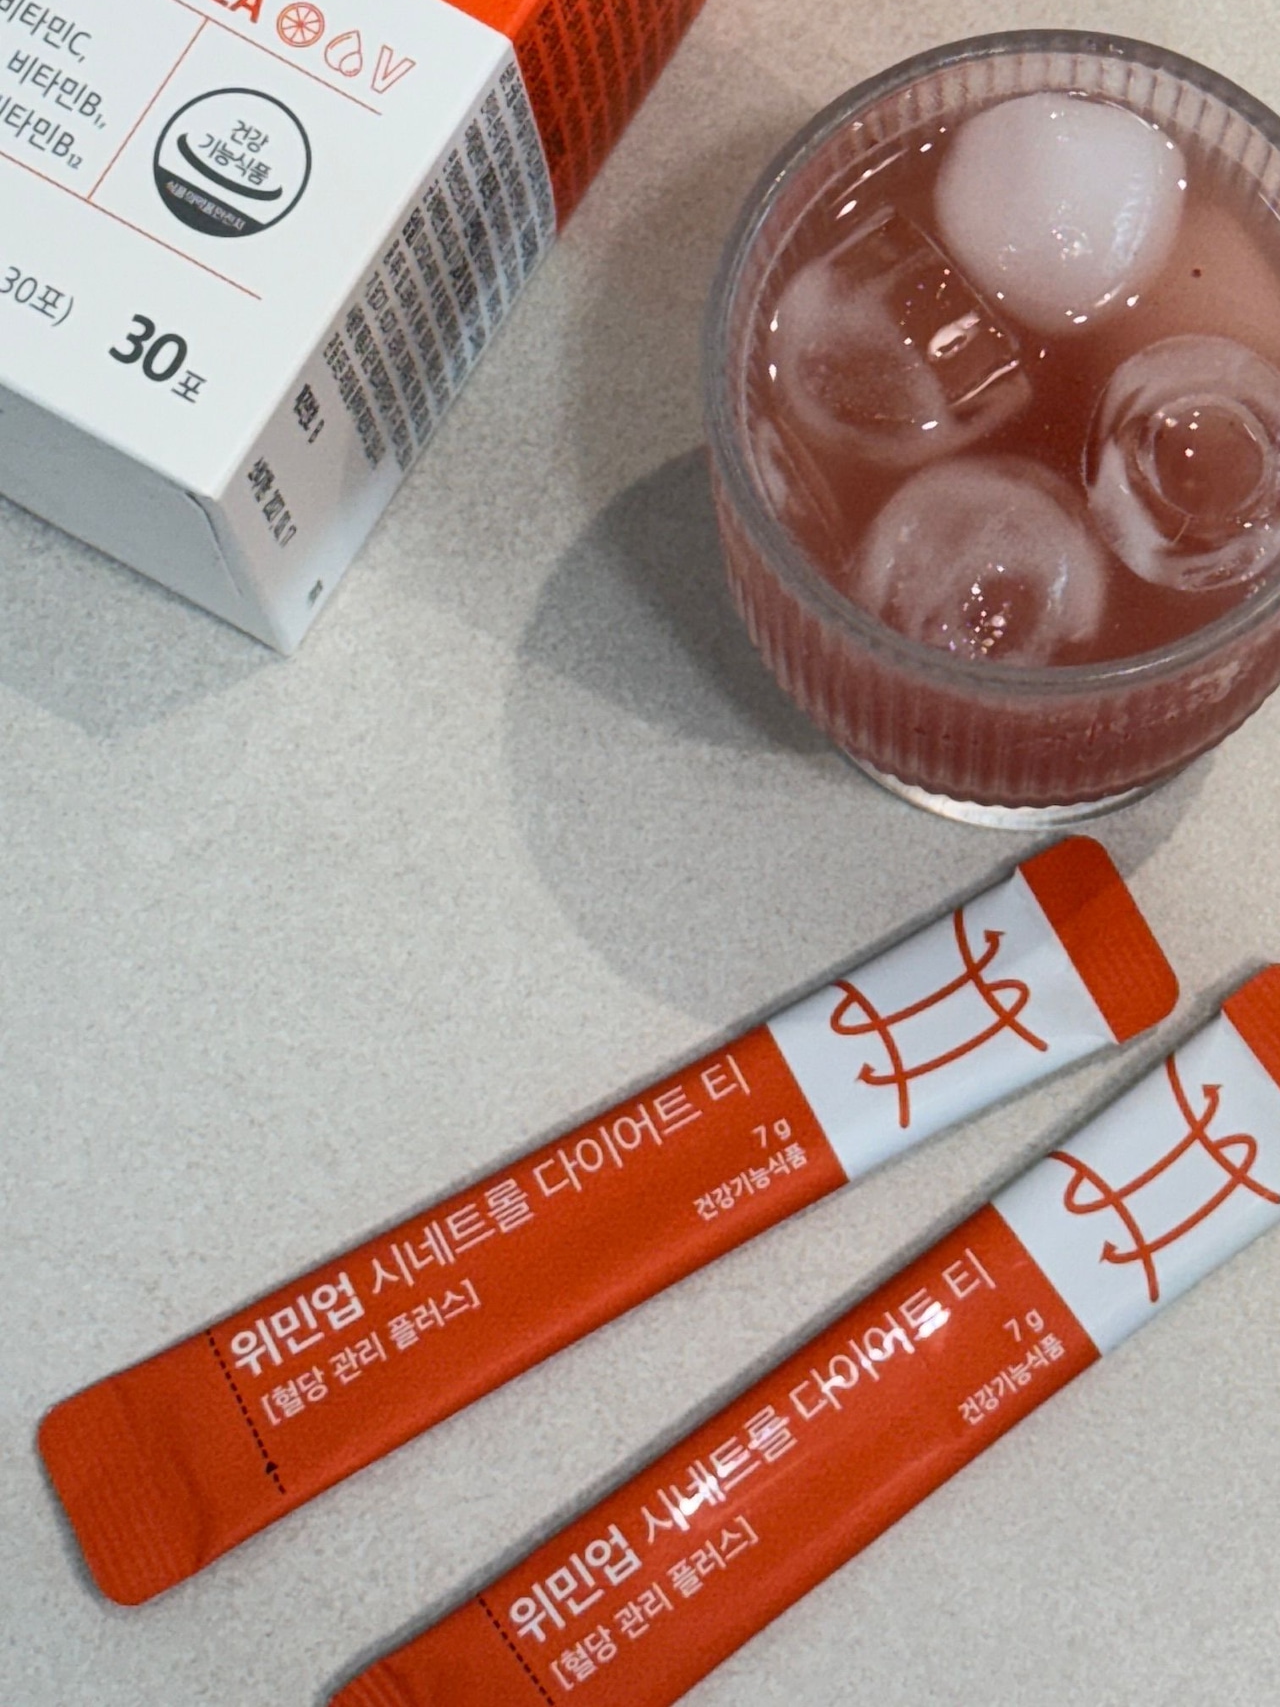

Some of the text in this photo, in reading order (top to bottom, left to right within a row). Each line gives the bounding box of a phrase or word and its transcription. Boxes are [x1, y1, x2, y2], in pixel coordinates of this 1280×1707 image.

[198, 133, 272, 185] 기능식품
[230, 119, 269, 153] 건강
[230, 1054, 752, 1378] 위민업 시네트롤 다이어트 티
[692, 1142, 809, 1222] 건강기능식품
[330, 1337, 388, 1386] 관리
[957, 1334, 1066, 1427] 건강기능식품
[508, 1248, 997, 1645] 위민업 시네트롤 다이어트 티
[612, 1581, 674, 1641] 관리
